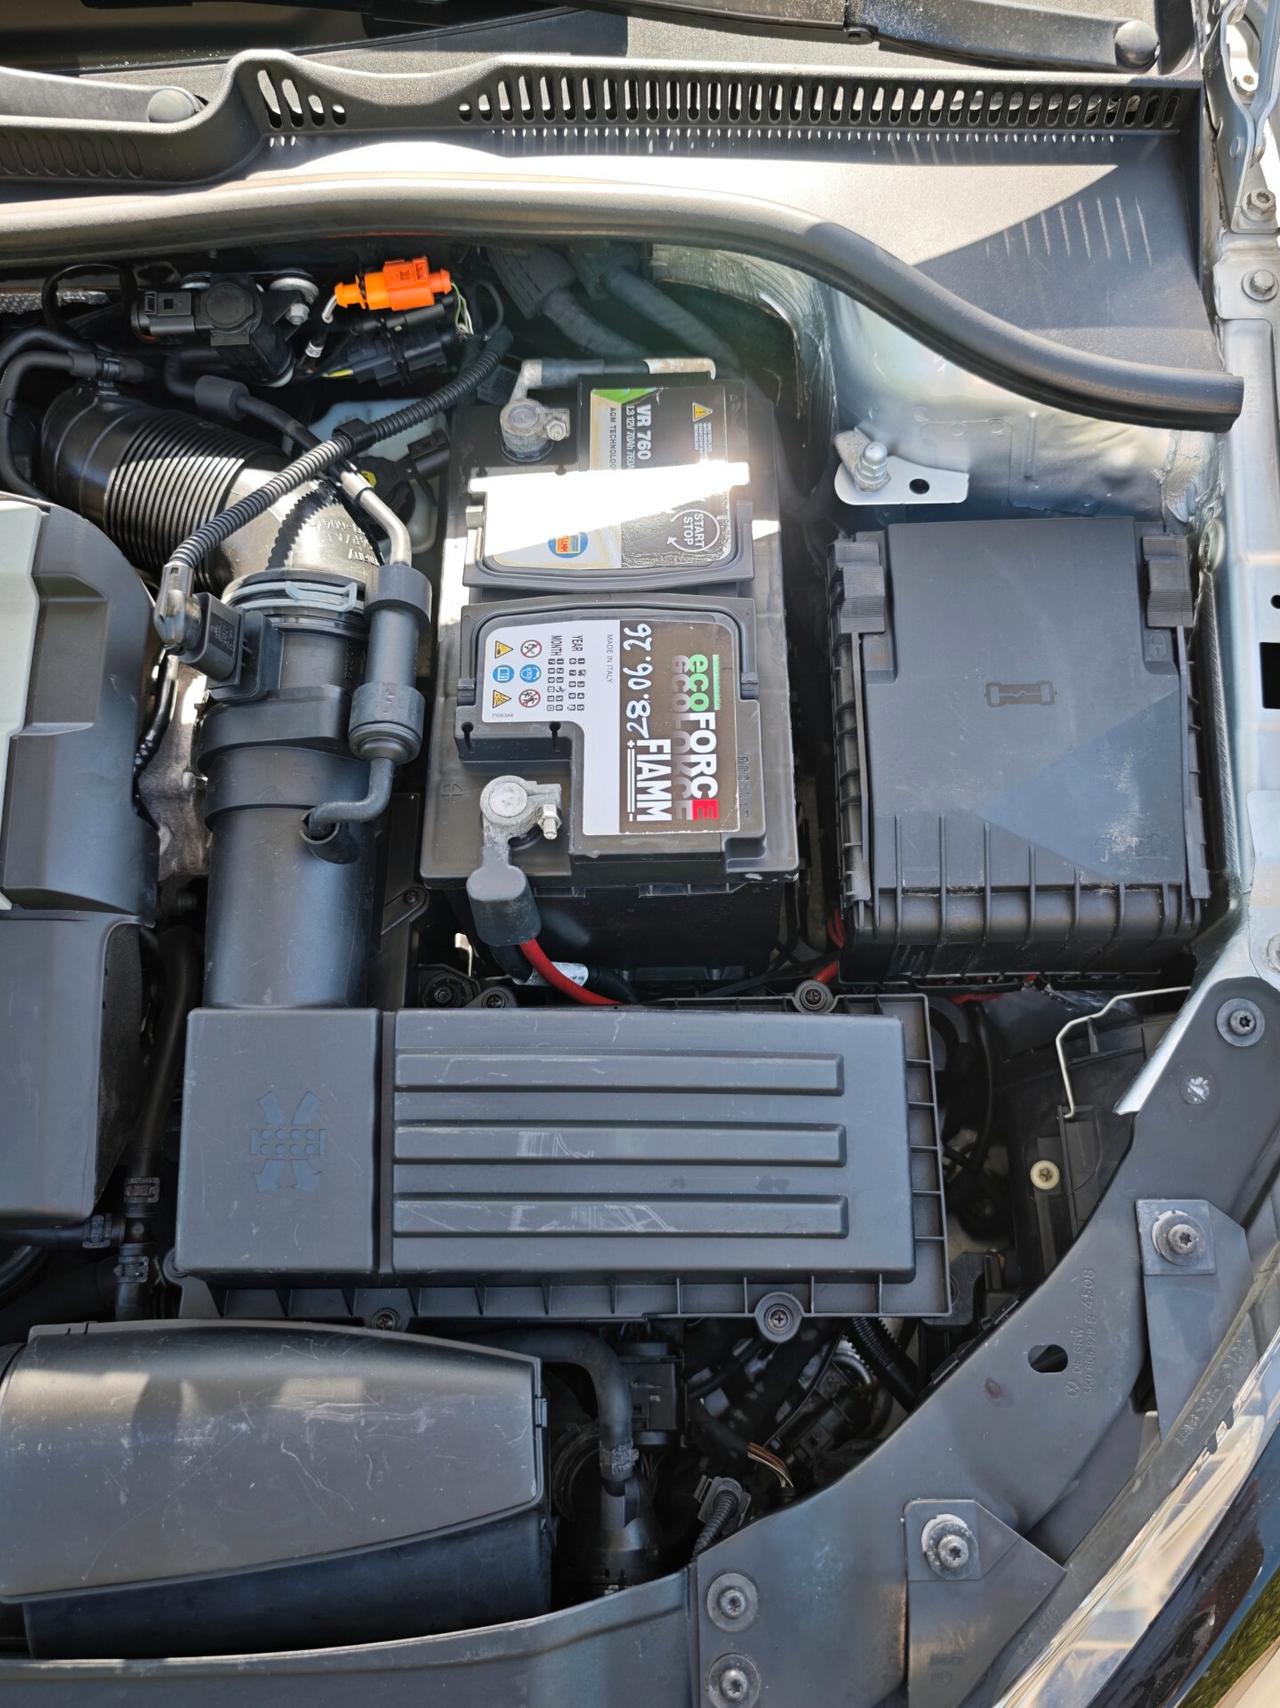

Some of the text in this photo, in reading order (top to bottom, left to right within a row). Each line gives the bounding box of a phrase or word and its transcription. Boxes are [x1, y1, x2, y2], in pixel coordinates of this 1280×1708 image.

[626, 405, 635, 416] L3
[626, 416, 635, 430] 12V
[626, 431, 635, 450] 70Ah
[637, 404, 652, 460] VR 760
[682, 516, 693, 546] STOP
[694, 513, 705, 548] START
[550, 635, 562, 656] MONTH
[572, 635, 583, 652] YEAR
[606, 634, 614, 683] MADE IN ITALY
[687, 654, 720, 821] ecoFORCE
[636, 739, 672, 822] FIAMM
